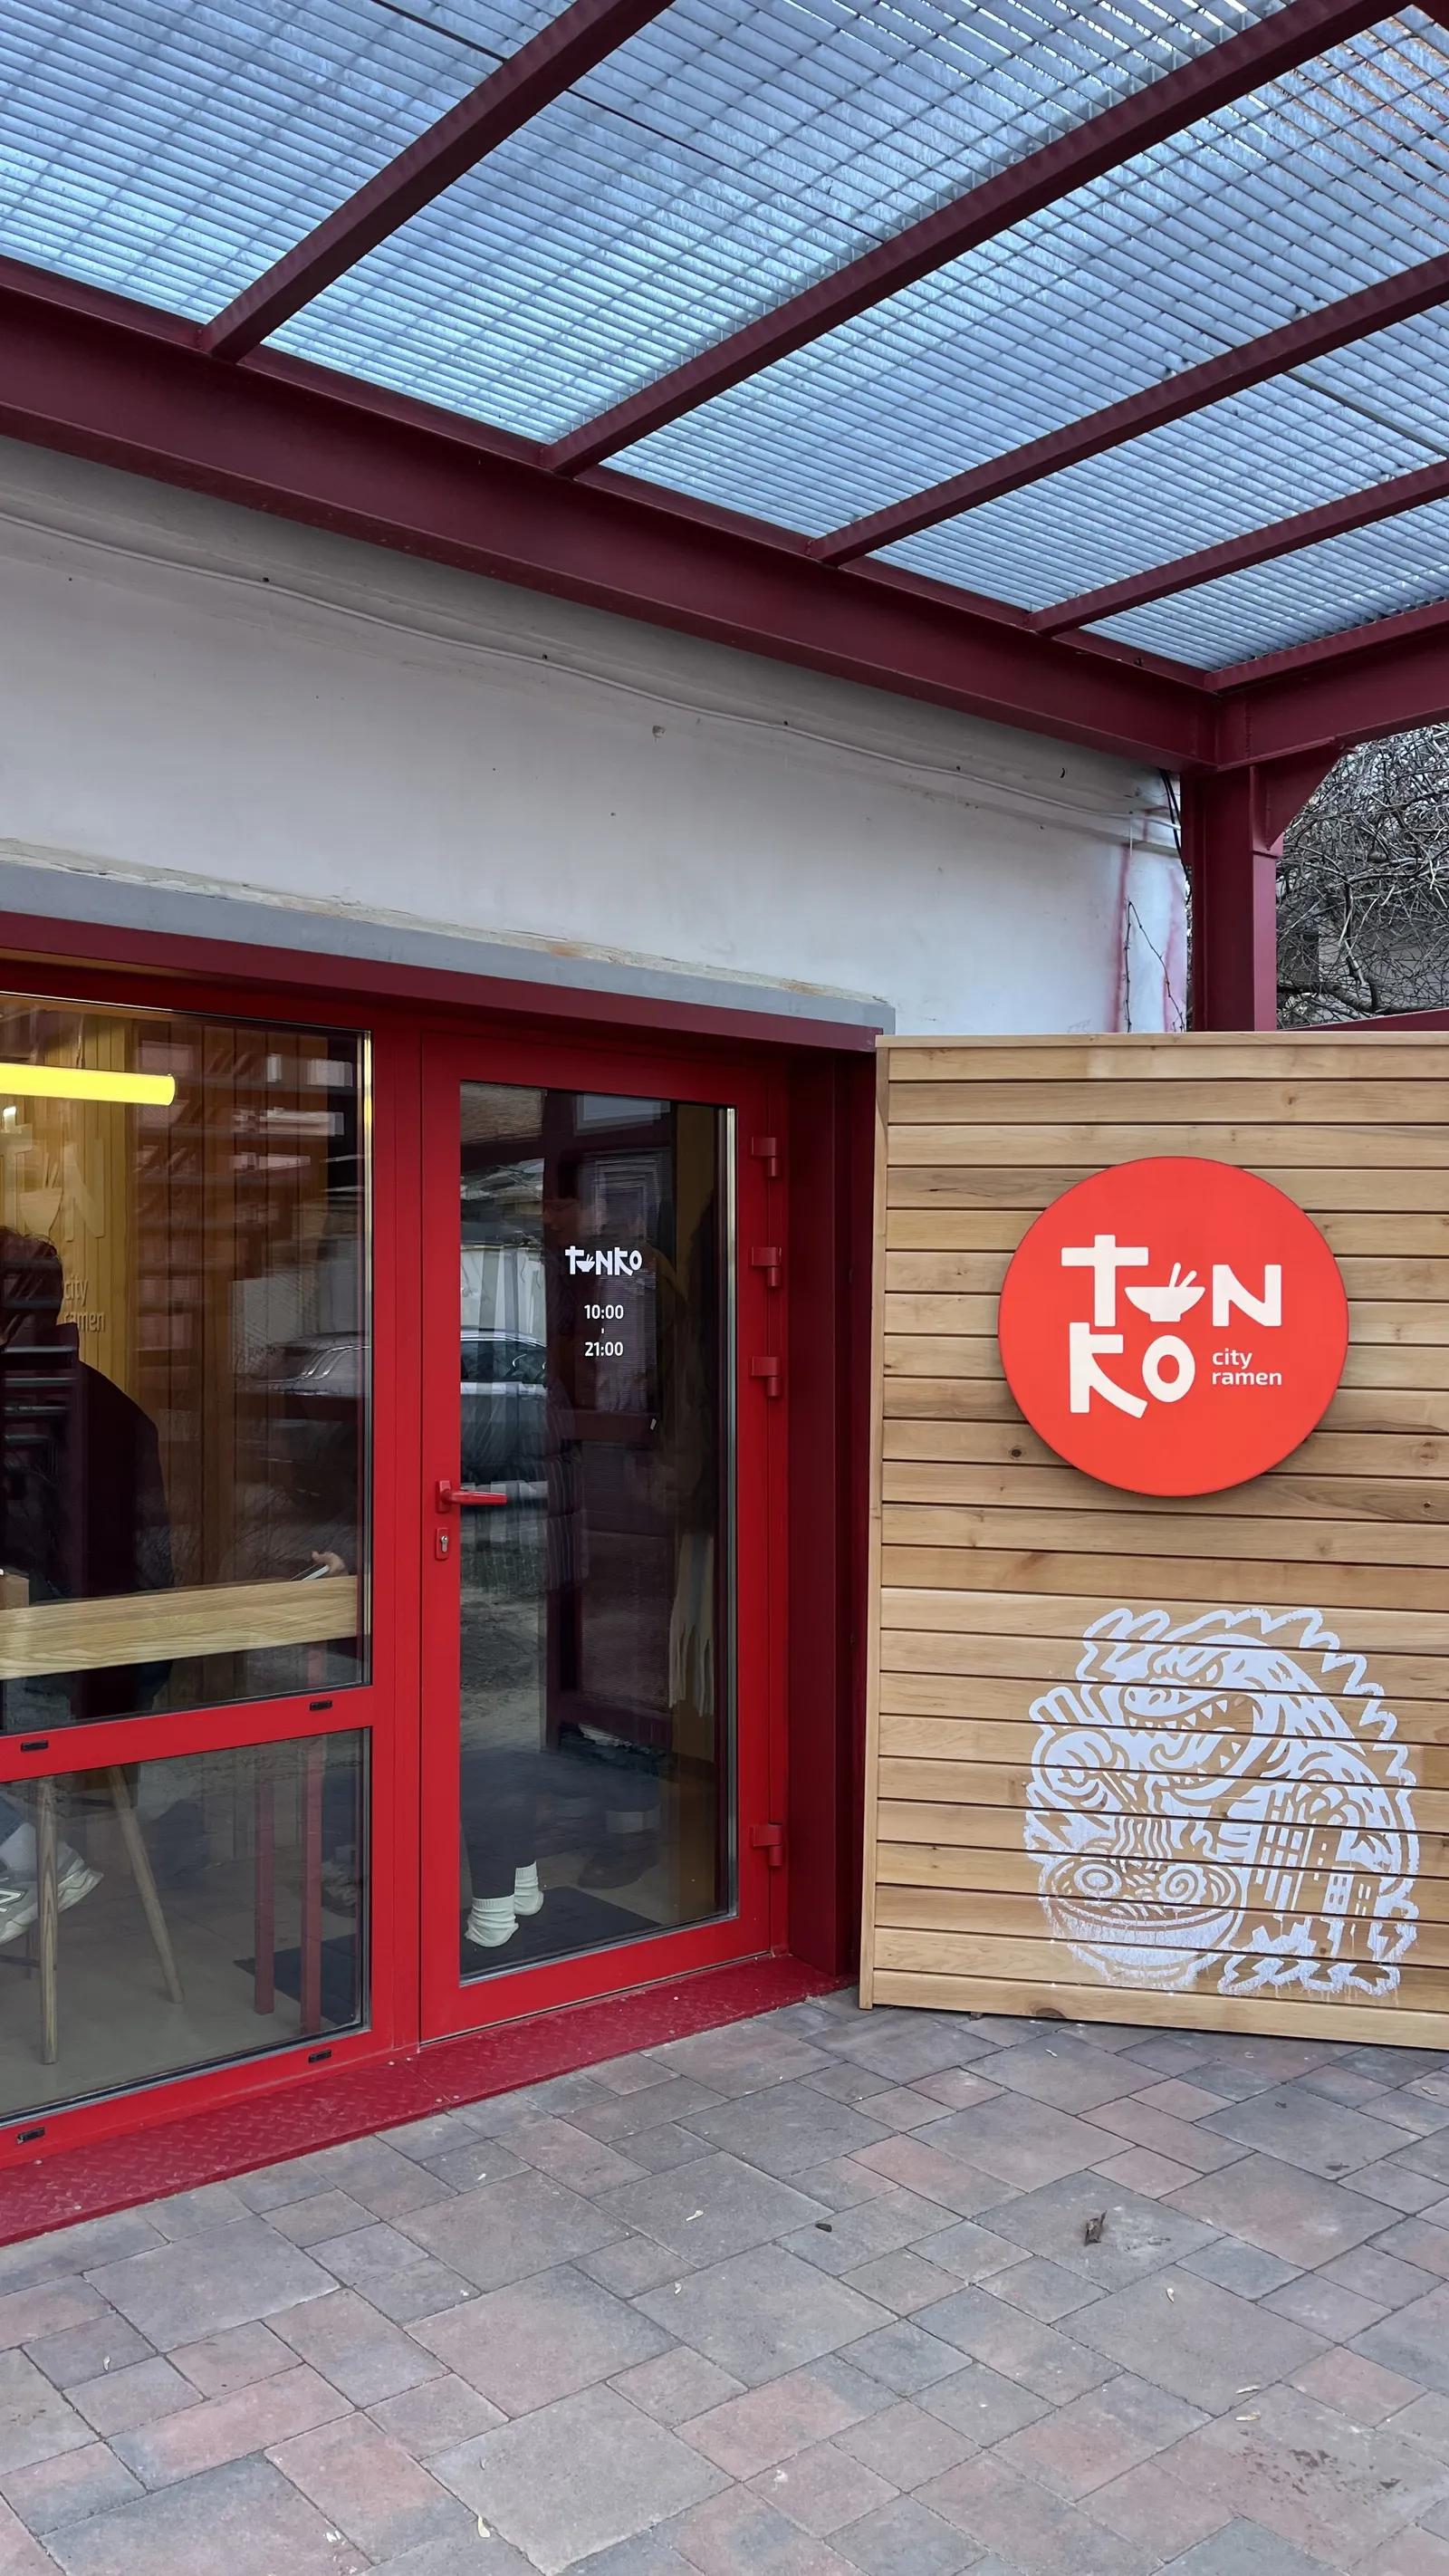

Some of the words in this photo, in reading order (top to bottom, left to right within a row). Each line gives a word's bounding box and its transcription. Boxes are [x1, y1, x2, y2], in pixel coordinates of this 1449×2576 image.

[64, 1274, 88, 1307] city
[584, 1304, 624, 1320] 10:00
[584, 1341, 624, 1357] 21:00
[1212, 1347, 1252, 1370] city
[1212, 1371, 1282, 1386] ramen
